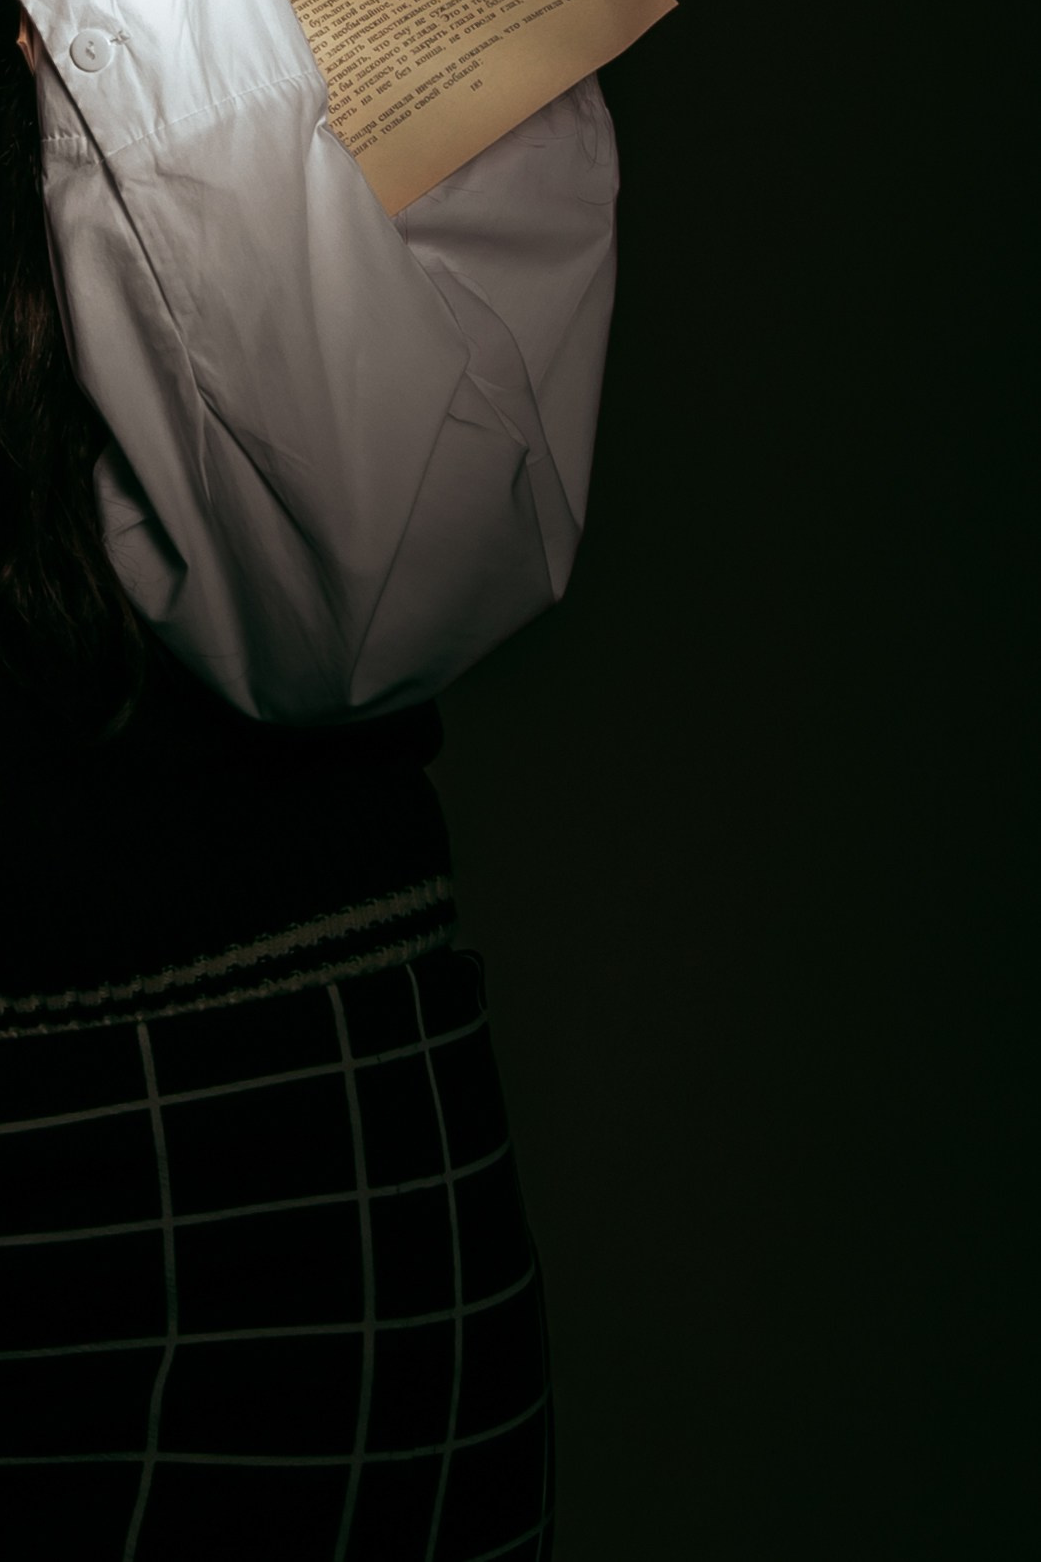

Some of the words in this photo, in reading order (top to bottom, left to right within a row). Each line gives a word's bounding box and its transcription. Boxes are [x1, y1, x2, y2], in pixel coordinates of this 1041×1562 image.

[330, 6, 359, 28] такой
[371, 38, 391, 54] что
[391, 25, 412, 42] ему
[413, 15, 427, 27] не
[341, 117, 378, 149] Сондра
[376, 91, 414, 122] сначала
[413, 70, 445, 95] ничем
[443, 61, 458, 74] не
[457, 31, 505, 66] показала,
[502, 21, 521, 36] что
[379, 108, 413, 135] только
[412, 86, 441, 111] своей
